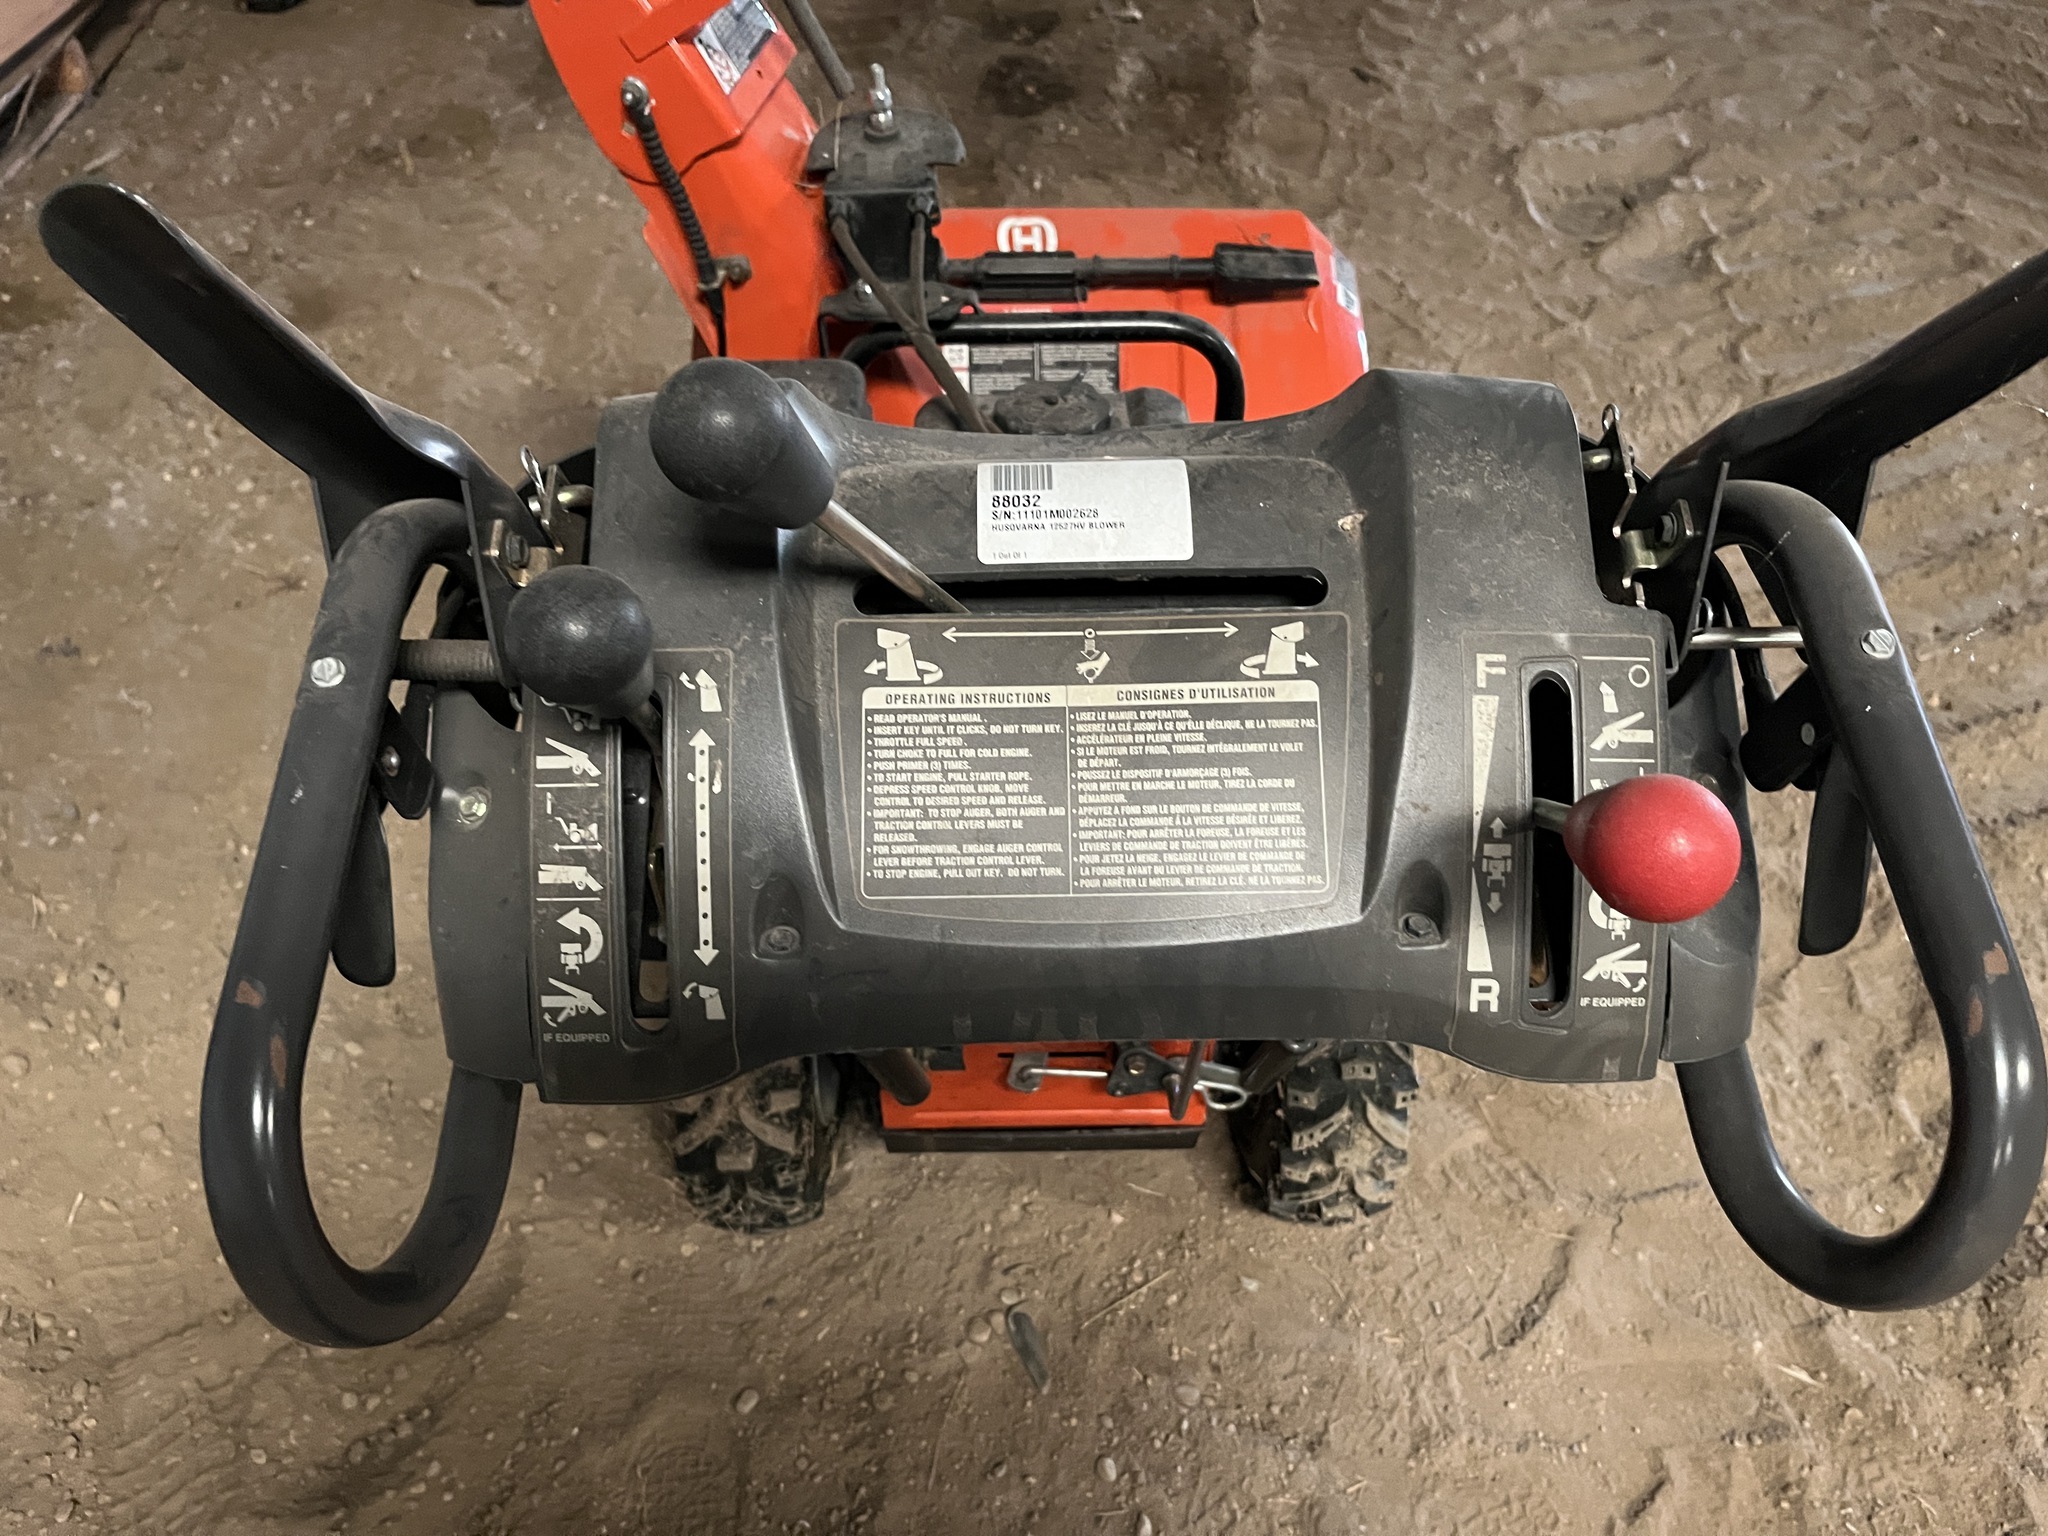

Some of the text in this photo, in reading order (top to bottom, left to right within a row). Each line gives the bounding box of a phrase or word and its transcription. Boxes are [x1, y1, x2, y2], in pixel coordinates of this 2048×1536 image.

[992, 495, 1041, 508] 88032
[992, 523, 1045, 531] HUSQVARNA
[1476, 653, 1507, 688] F
[886, 693, 1051, 704] OPERATING INSTRUCTIONS
[1117, 687, 1275, 701] CONSIGNES D'UTILISATION
[874, 714, 895, 723] READ
[897, 714, 946, 723] OPERATOR'S
[874, 724, 1063, 735] INSERT KEY UNTIL IT CLICKS, DO NOT TURN KEY.
[874, 737, 914, 746] THROTTLE
[916, 737, 934, 746] FULL
[874, 748, 1032, 758] TURN CHOKE TO FULL FOR COLD ENGINE.
[874, 761, 971, 771] PUSH PRIMER (3) TIMES.
[874, 772, 1032, 783] TO START ENGINE, PULL STARTER ROPE.
[874, 785, 909, 794] DEPRESS
[911, 784, 937, 794] SPEED
[939, 784, 976, 793] CONTROL
[1005, 784, 1029, 793] MOVE
[874, 795, 1046, 806] CONTROL TO DESIRED SPEED AND RELEASE.
[873, 807, 1065, 818] IMPORTANT: TO STOP AUGER, BOTH AUGER AND
[874, 820, 1023, 830] TRACTION CONTROL LEVERS MUST BE
[874, 833, 917, 842] RELEASED.
[873, 845, 889, 854] FOR
[963, 844, 994, 853] ENGAGE
[997, 844, 1024, 853] AUGER
[1026, 843, 1063, 853] CONTROL
[874, 856, 1045, 866] LEVER BEFORE TRACTION CONTROL LEVER.
[873, 870, 884, 879] TO
[886, 869, 907, 878] STOP
[944, 869, 963, 878] PULL
[966, 869, 981, 878] OUT
[983, 868, 1003, 877] KEY.
[1008, 868, 1019, 877] DO
[1022, 868, 1037, 877] NOT
[1040, 868, 1065, 877] TURN.
[1469, 977, 1501, 1013] R
[1580, 997, 1646, 1007] IF EQUIPPED
[543, 1033, 611, 1042] IF EQUIPPED
